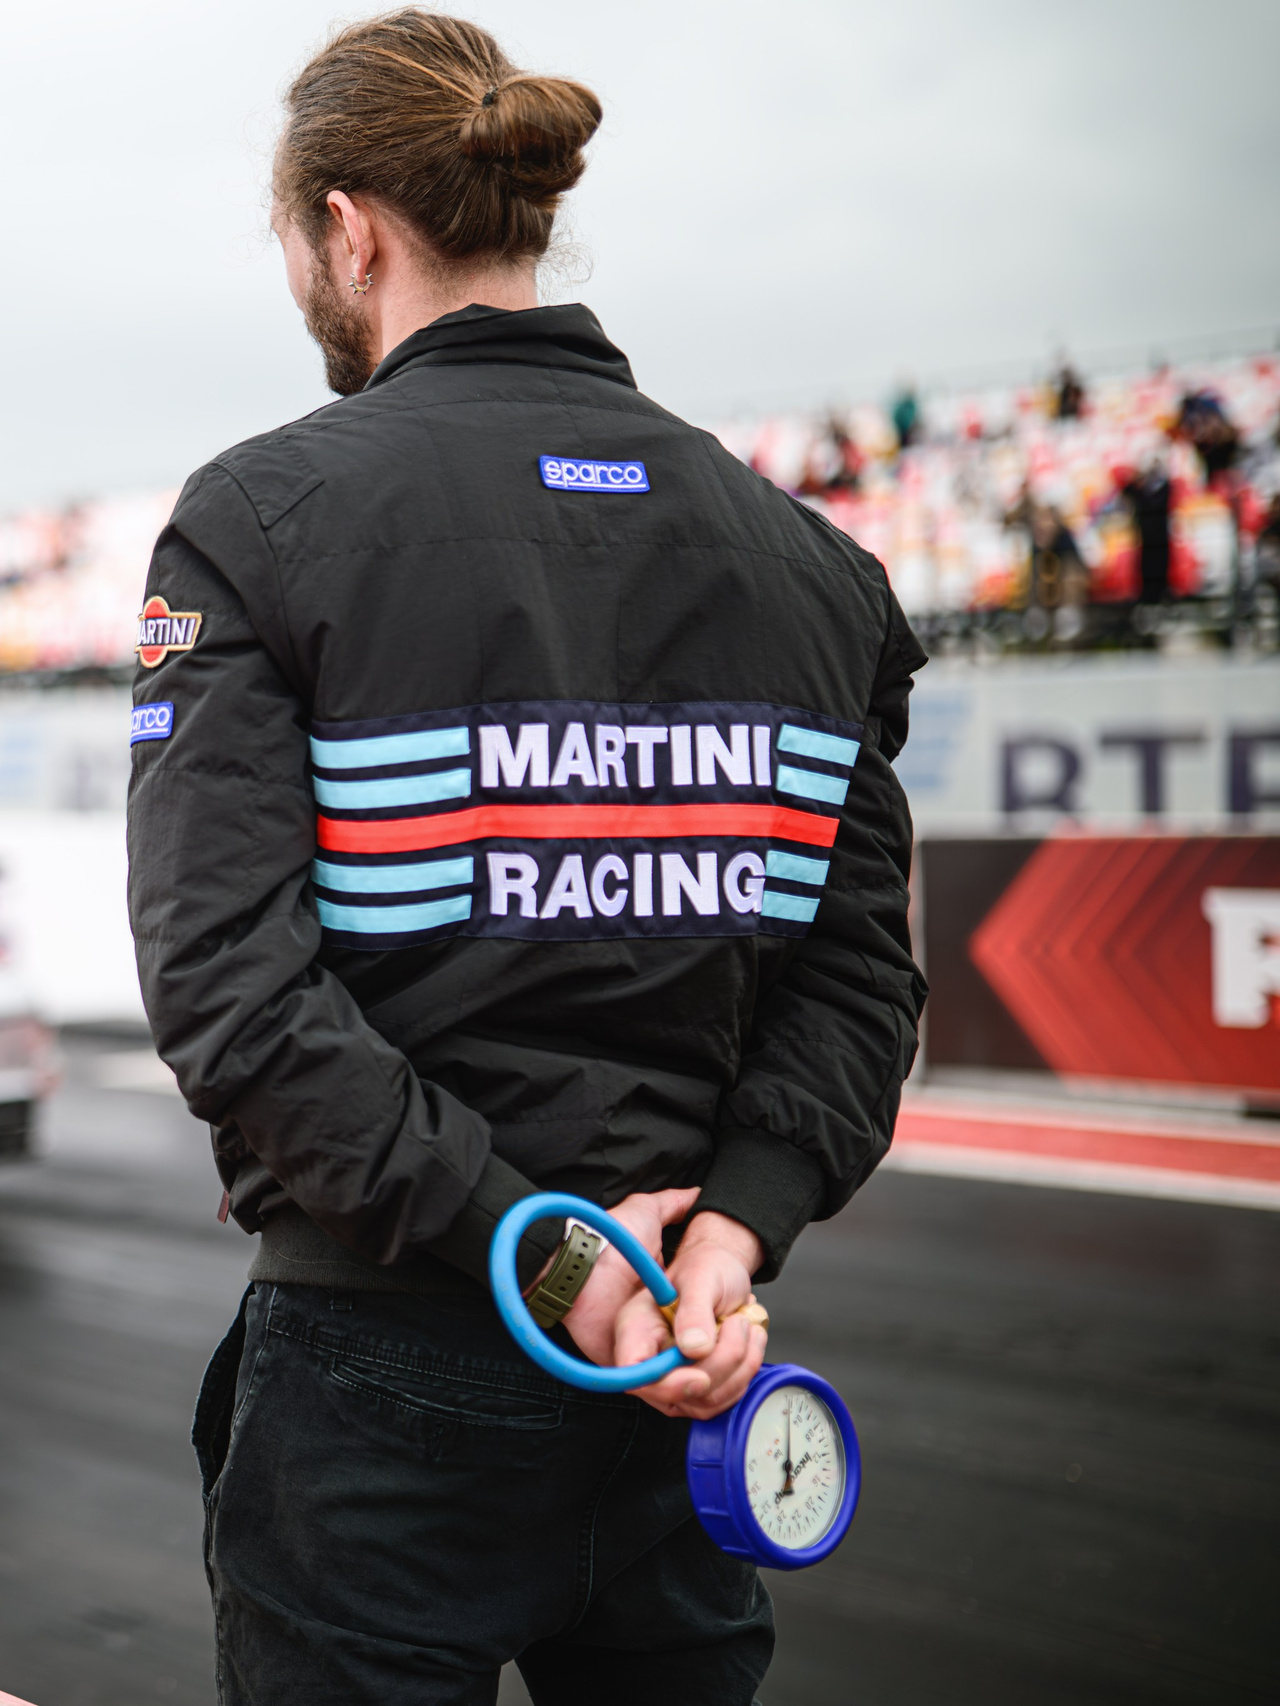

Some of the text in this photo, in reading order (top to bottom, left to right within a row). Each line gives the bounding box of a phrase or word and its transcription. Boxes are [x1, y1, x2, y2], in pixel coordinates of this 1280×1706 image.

[544, 460, 643, 488] sparco
[131, 706, 171, 732] arco
[478, 722, 772, 788] MARTINI
[486, 851, 766, 919] RACING
